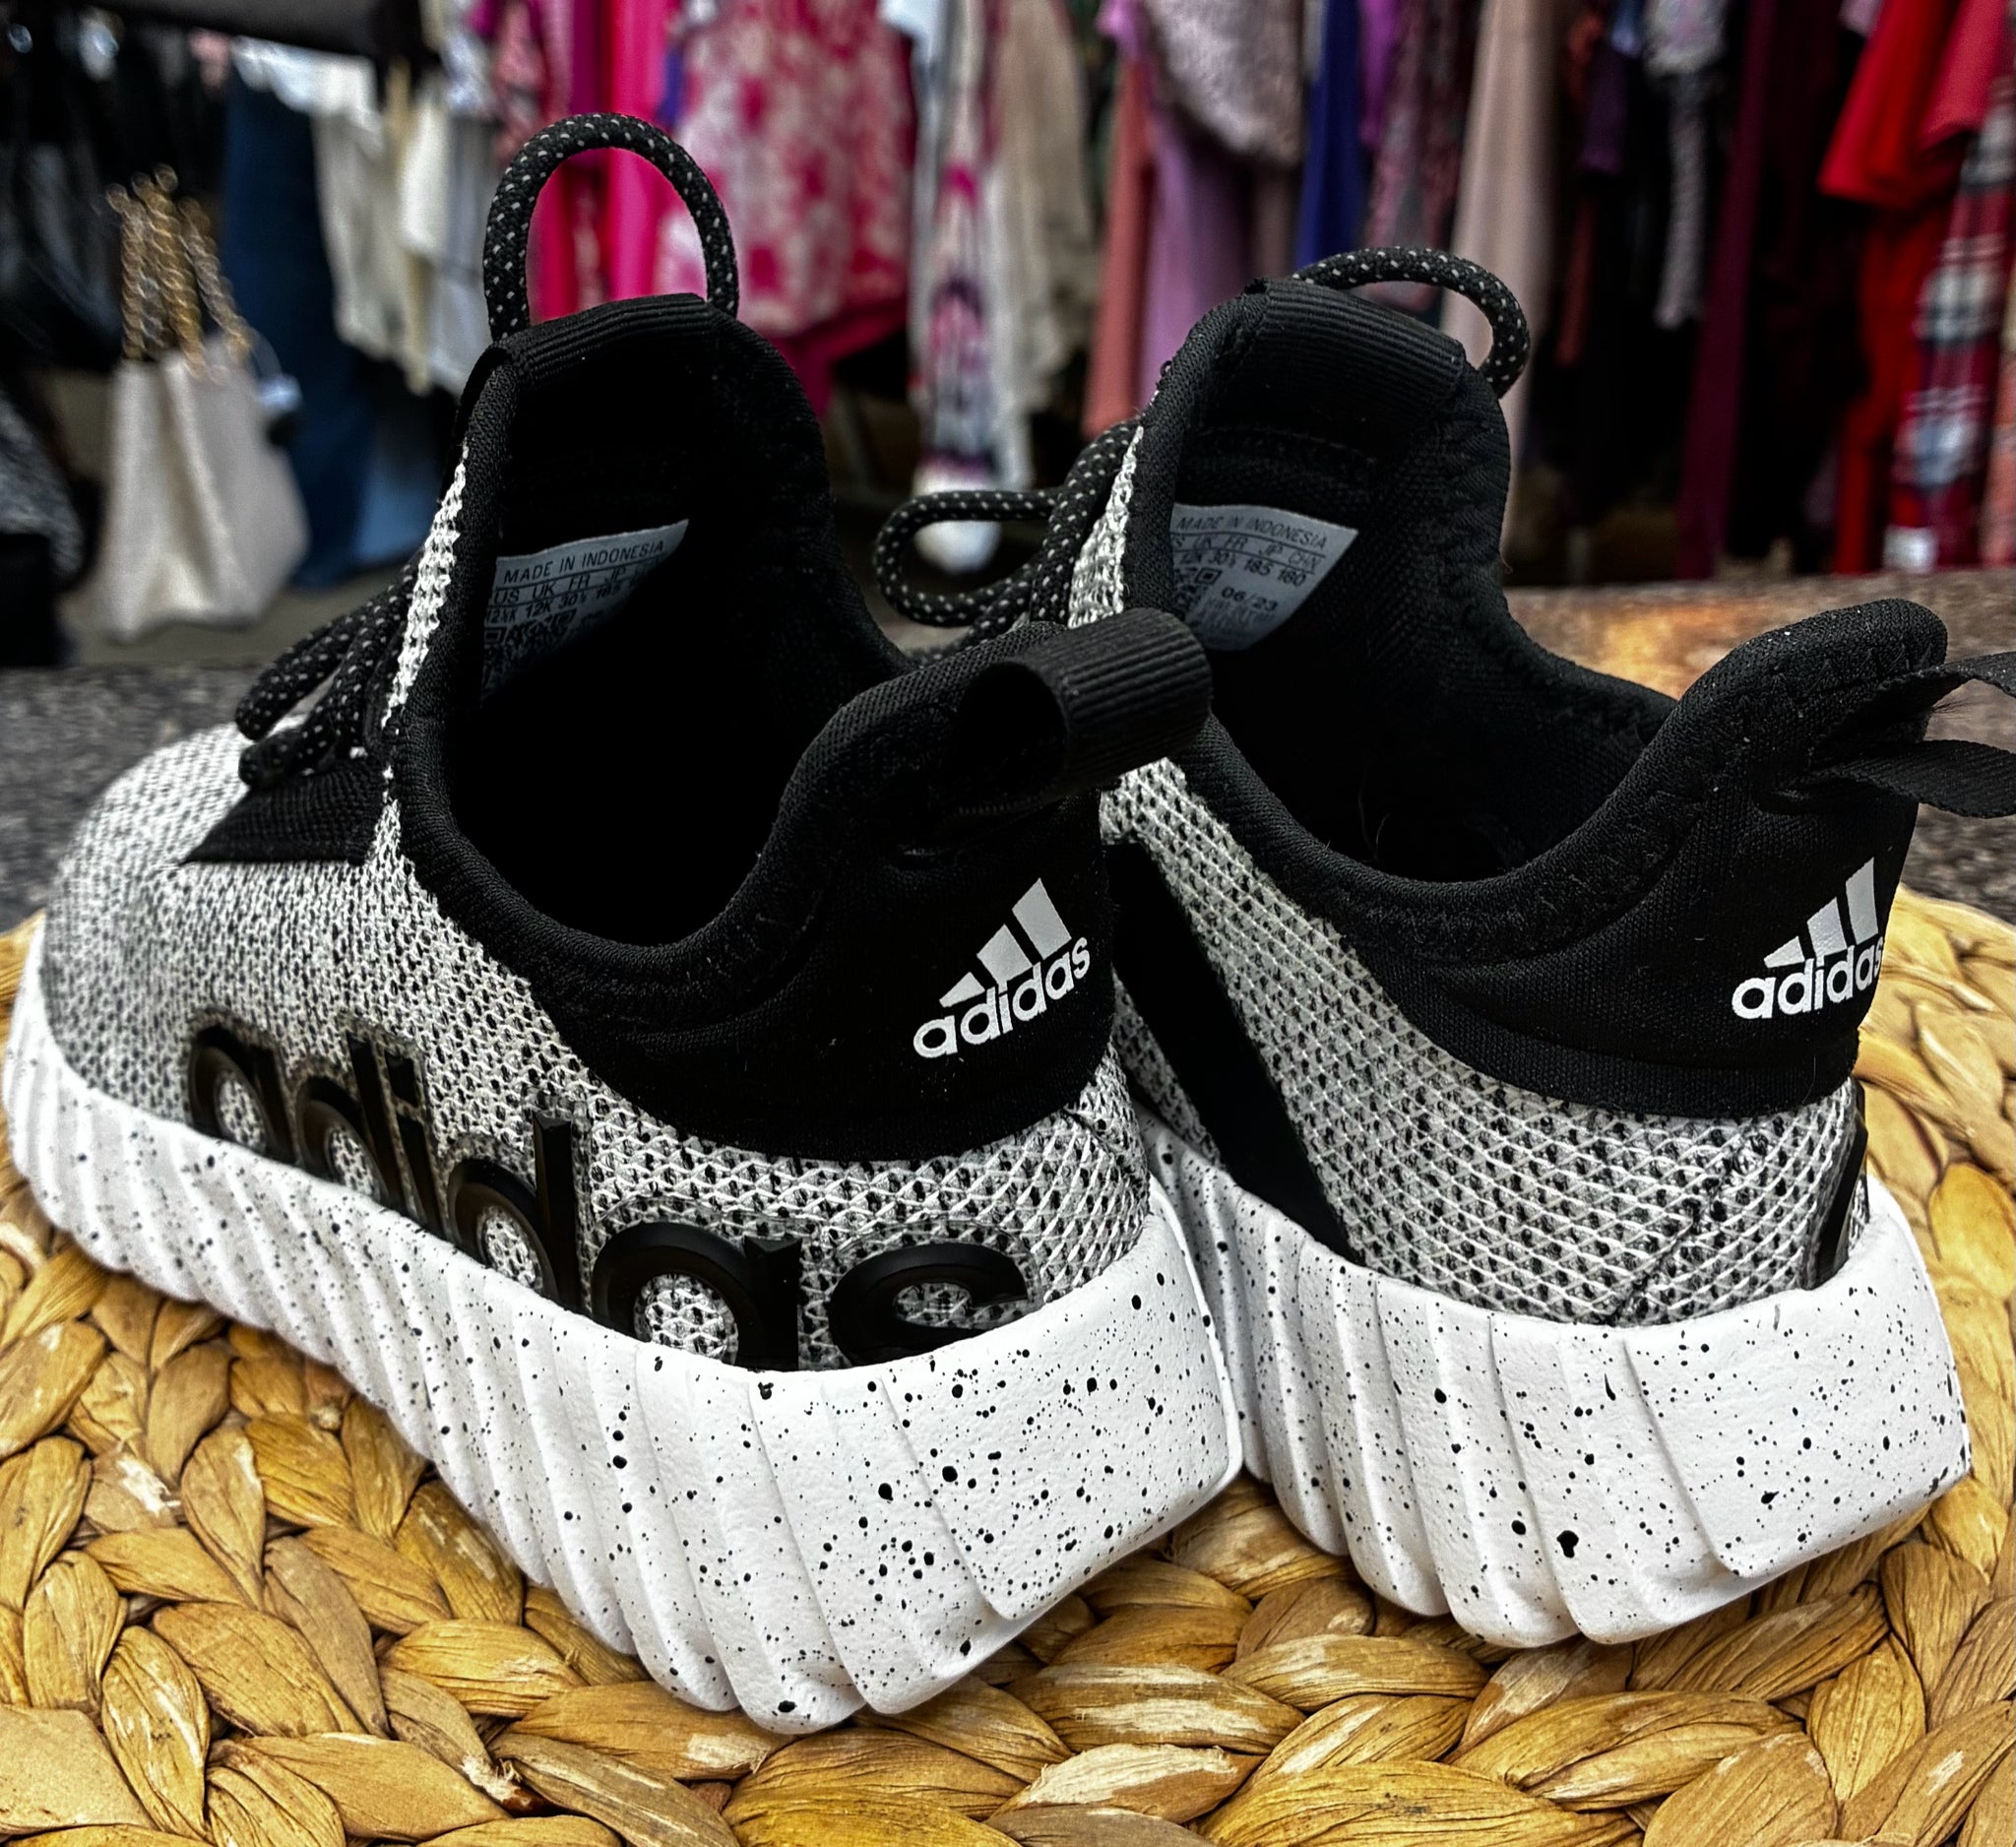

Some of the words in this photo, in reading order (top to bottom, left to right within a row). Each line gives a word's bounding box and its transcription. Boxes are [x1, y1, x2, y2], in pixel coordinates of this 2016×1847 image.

[1176, 516, 1224, 530] MADE
[1228, 515, 1244, 529] IN
[1245, 518, 1328, 550] INDONESIA
[504, 561, 553, 584] MADE
[559, 556, 576, 573] IN
[582, 541, 663, 568] INDONESIA
[1244, 557, 1274, 576] 185
[1277, 568, 1307, 587] 180
[493, 589, 520, 605] US
[532, 581, 556, 600] UK
[526, 599, 553, 618] 12K
[1732, 936, 1884, 1019] adidas
[914, 937, 1090, 1058] adidas
